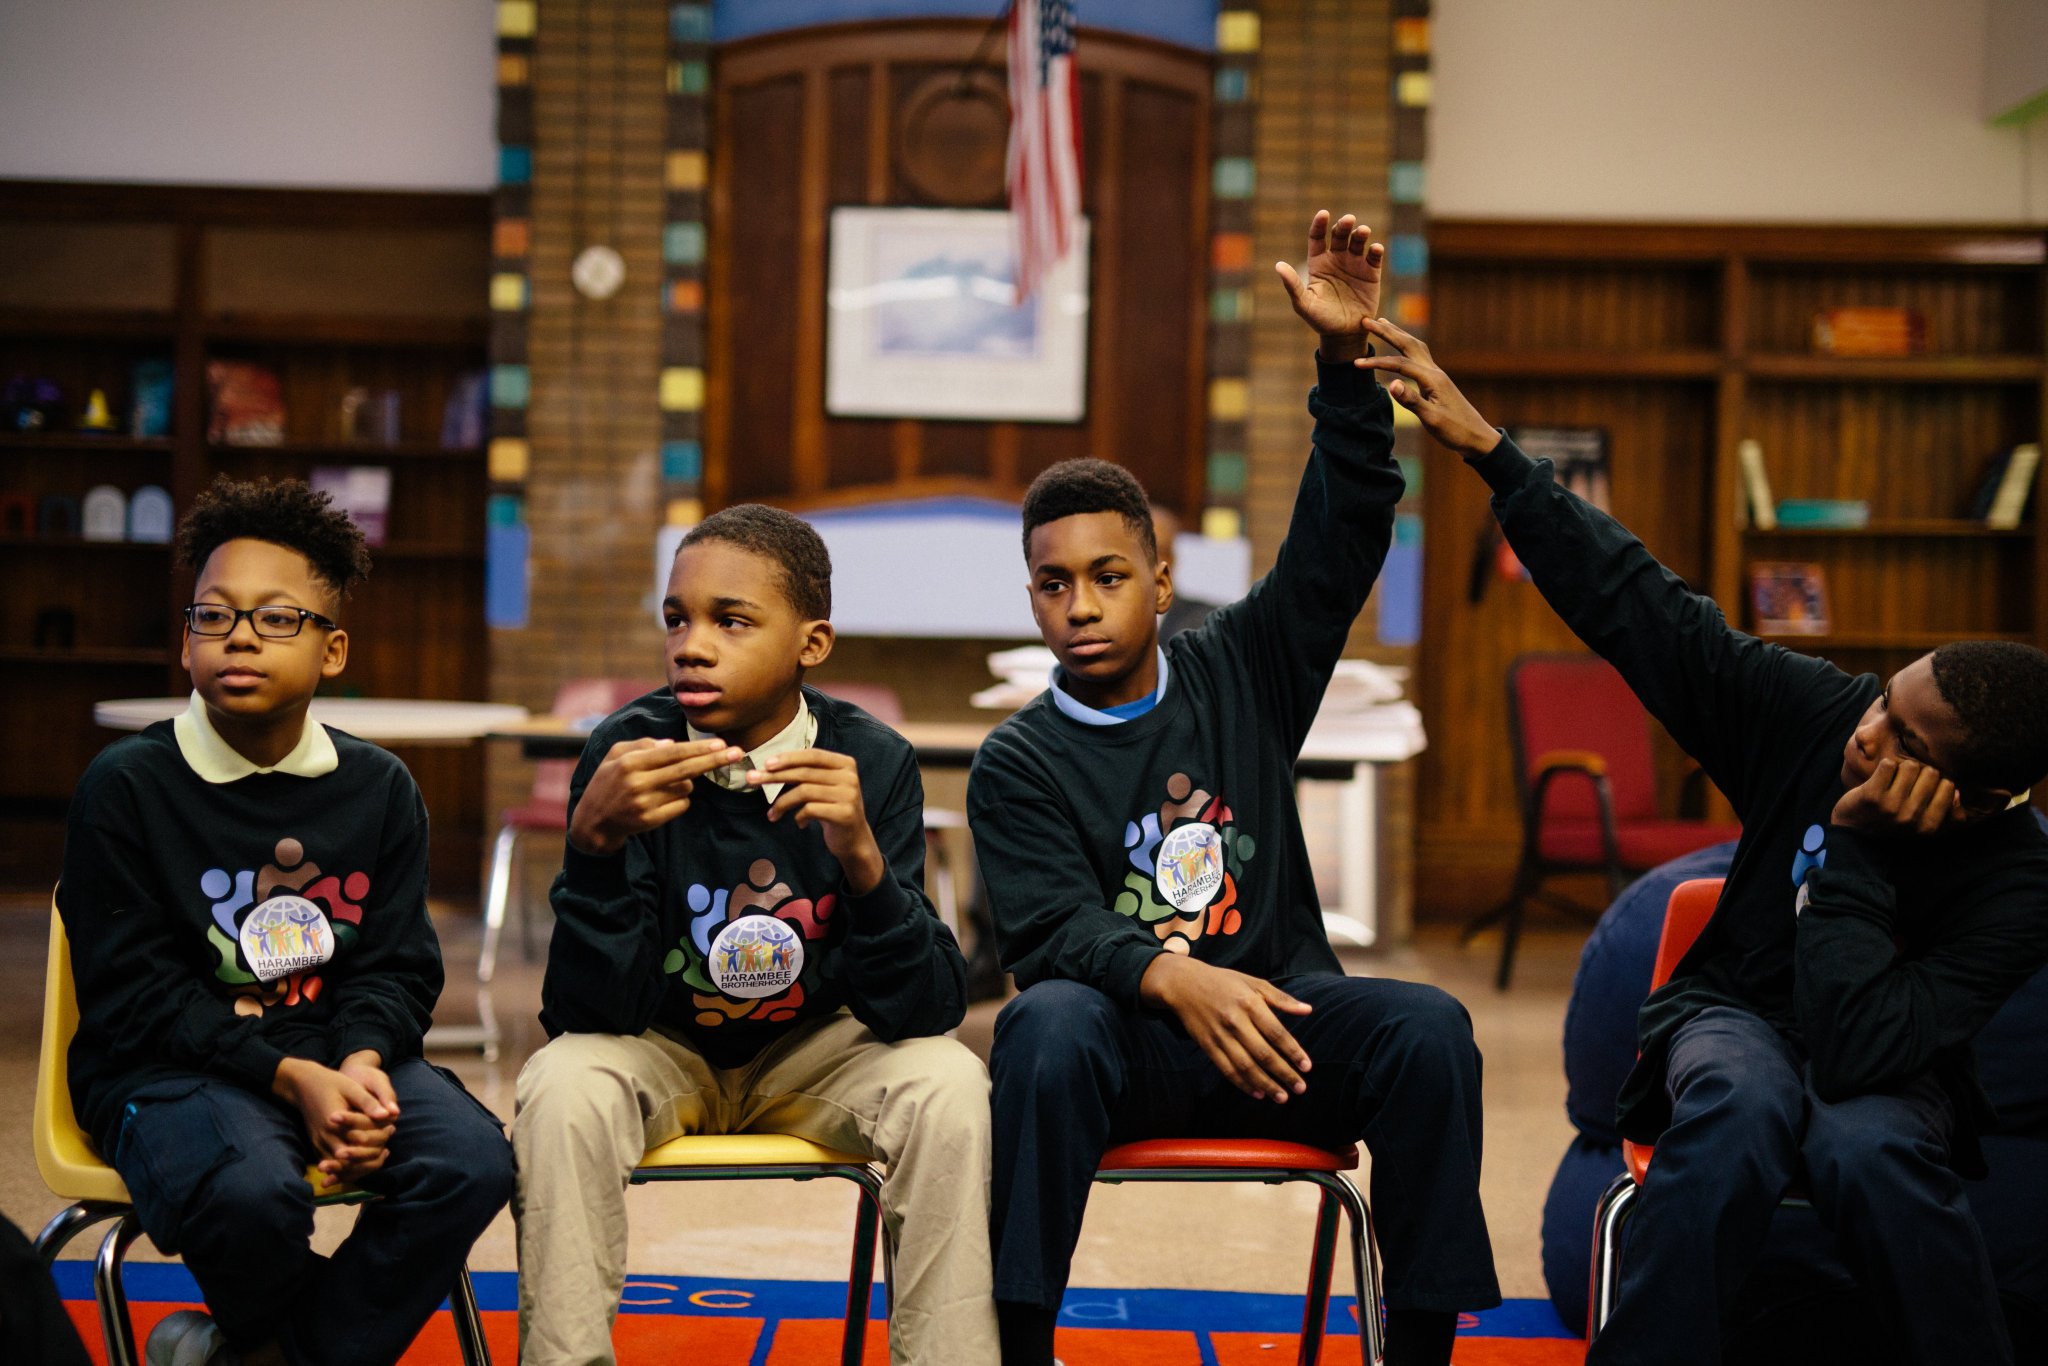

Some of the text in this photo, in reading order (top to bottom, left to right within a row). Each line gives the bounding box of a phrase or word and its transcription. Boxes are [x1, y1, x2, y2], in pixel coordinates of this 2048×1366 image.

[258, 955, 324, 969] HARAMBEE
[721, 970, 792, 982] HARAMBEE
[721, 978, 791, 989] BROTHERHOOD
